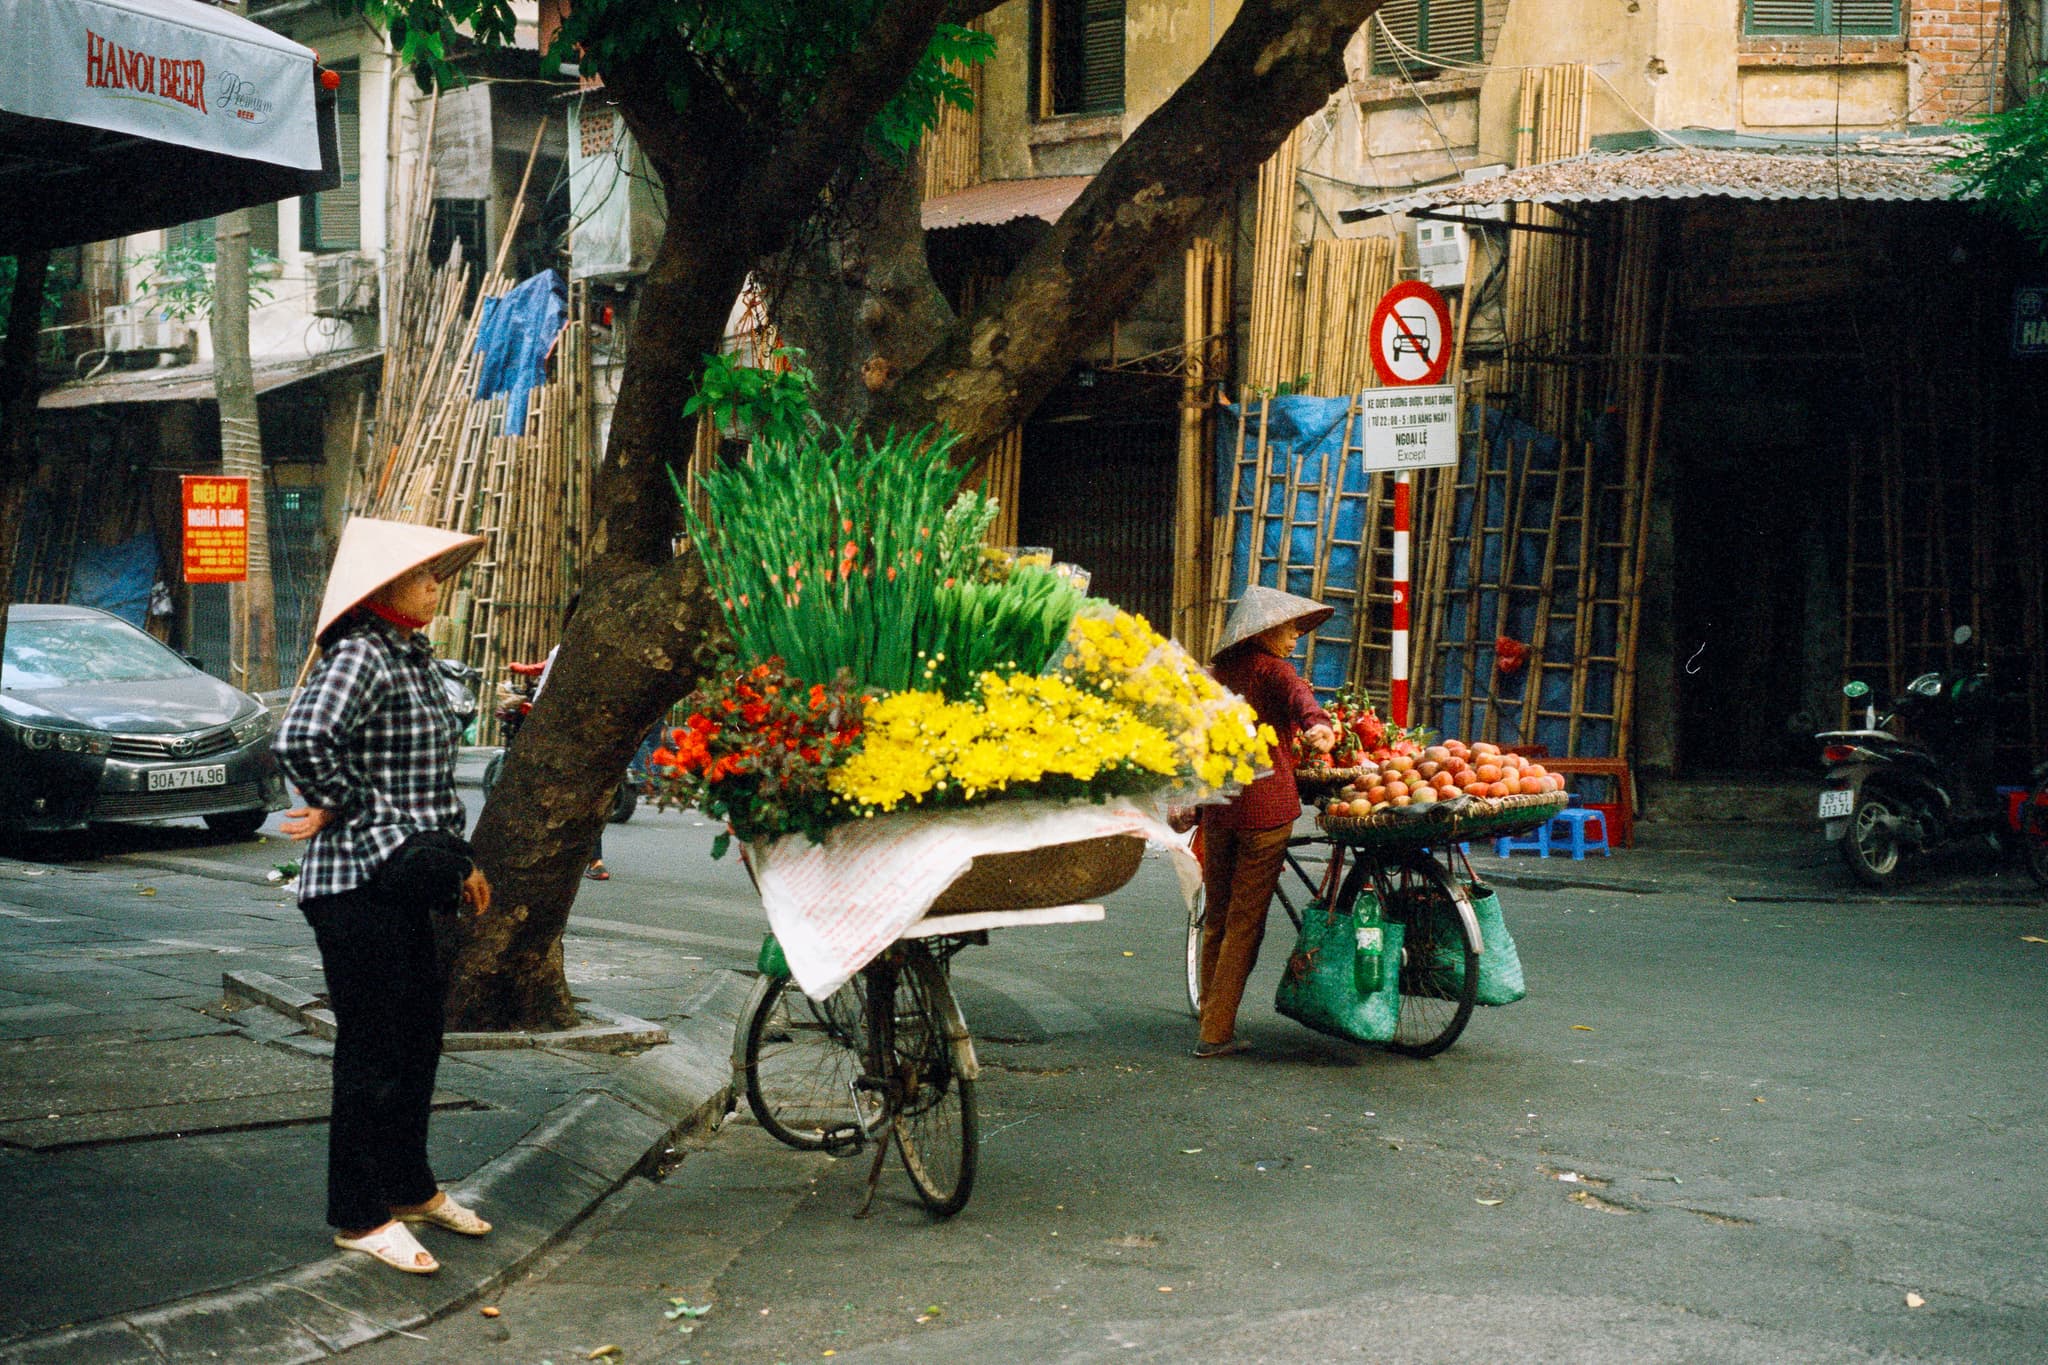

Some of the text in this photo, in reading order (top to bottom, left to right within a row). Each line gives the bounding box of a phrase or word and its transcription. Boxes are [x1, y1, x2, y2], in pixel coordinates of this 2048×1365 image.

[85, 27, 208, 115] HANOI BEER
[216, 70, 273, 112] Premium
[236, 109, 255, 120] BEER
[1395, 431, 1418, 447] NGOẠI
[1397, 449, 1427, 463] Except
[151, 768, 224, 789] 30A-714.96
